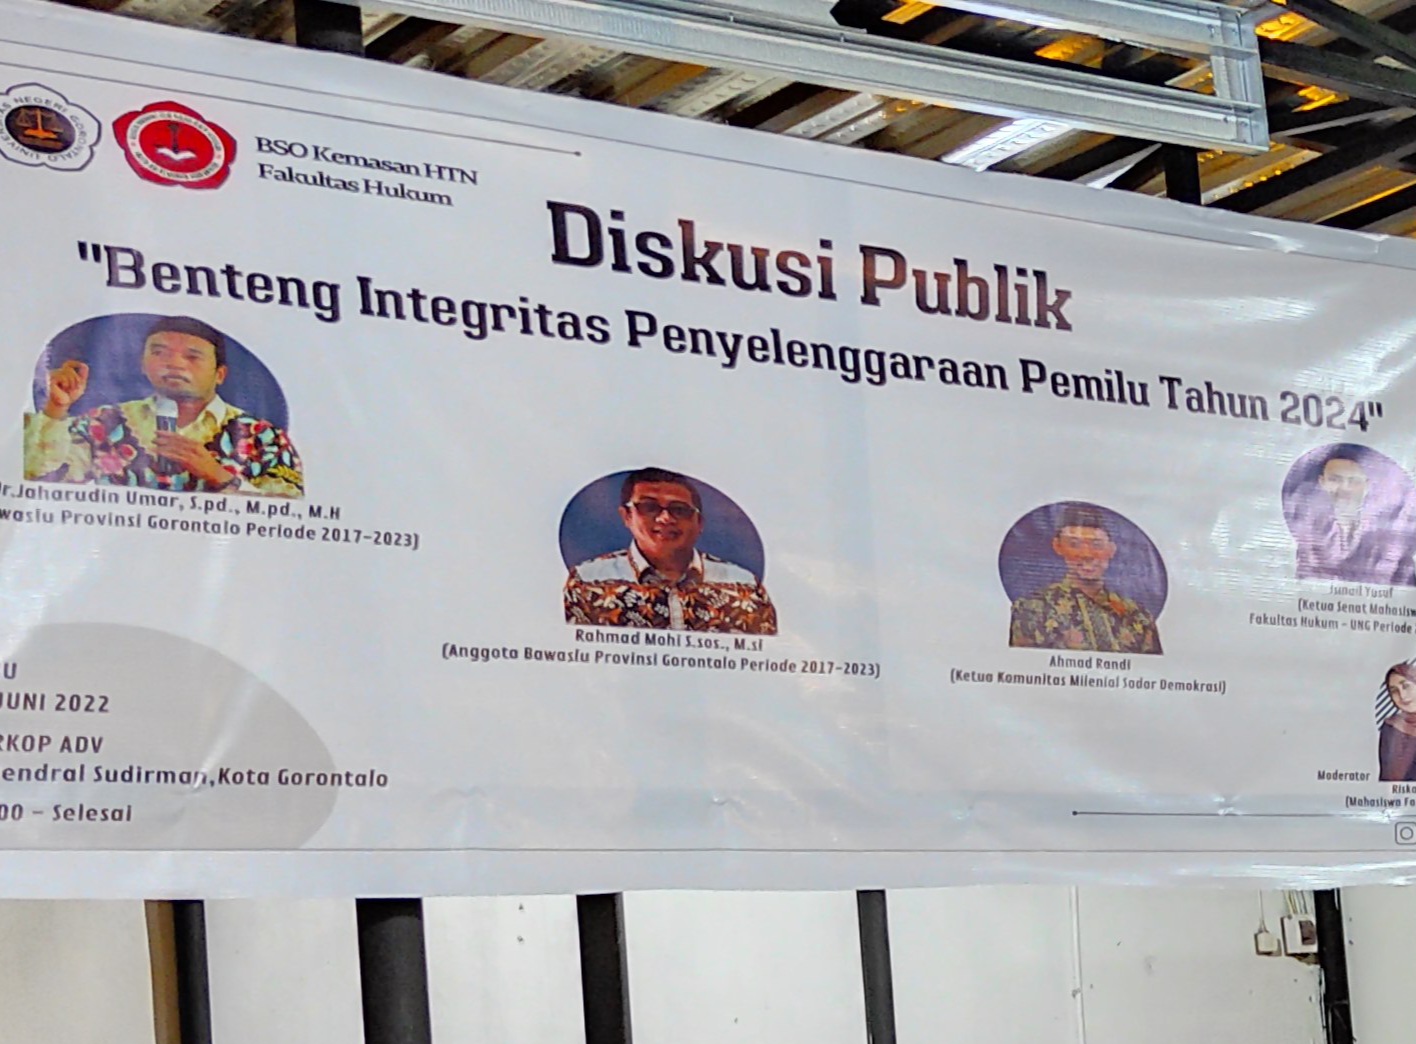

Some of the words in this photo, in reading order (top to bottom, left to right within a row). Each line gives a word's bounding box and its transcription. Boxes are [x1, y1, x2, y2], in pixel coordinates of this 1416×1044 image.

[254, 136, 309, 158] BSO
[312, 145, 421, 177] Kemasan
[423, 163, 478, 186] HTN
[257, 163, 360, 193] Fakultas
[362, 178, 455, 207] Hukum
[546, 199, 838, 302] Diskusi
[858, 243, 1074, 332] Publik
[77, 240, 341, 324] "Benteng
[357, 275, 612, 345] Integritas
[625, 309, 1009, 393] Penyelenggaraan
[1018, 358, 1152, 408] Pemilu
[1159, 375, 1271, 422] Tahun
[1280, 391, 1384, 432] 2024"
[61, 509, 142, 528] Provinsi
[147, 514, 241, 536] Gorontalo
[246, 522, 316, 541] Periode
[321, 527, 419, 550] 2017-2023)
[1337, 601, 1367, 615] Senat
[1249, 612, 1298, 628] Fakultas
[1300, 616, 1339, 630] Hukum
[1373, 620, 1413, 634] Periode
[575, 628, 640, 645] Rahmad
[441, 642, 519, 662] (Anggota
[594, 650, 658, 667] Provinsi
[662, 652, 737, 670] Gorontalo
[741, 657, 797, 673] Periode
[801, 660, 881, 679] 2017-2023)
[1049, 655, 1093, 670] Ahmad
[1096, 657, 1131, 671] Randi
[950, 667, 994, 684] (Ketua
[997, 671, 1066, 687] Komunitas
[1160, 679, 1227, 695] Demokrasi)
[54, 693, 110, 713] 2022
[59, 735, 104, 754] ADV
[277, 767, 389, 789] Gorontalo
[1317, 770, 1371, 782] Moderator
[52, 803, 133, 822] Selesai
